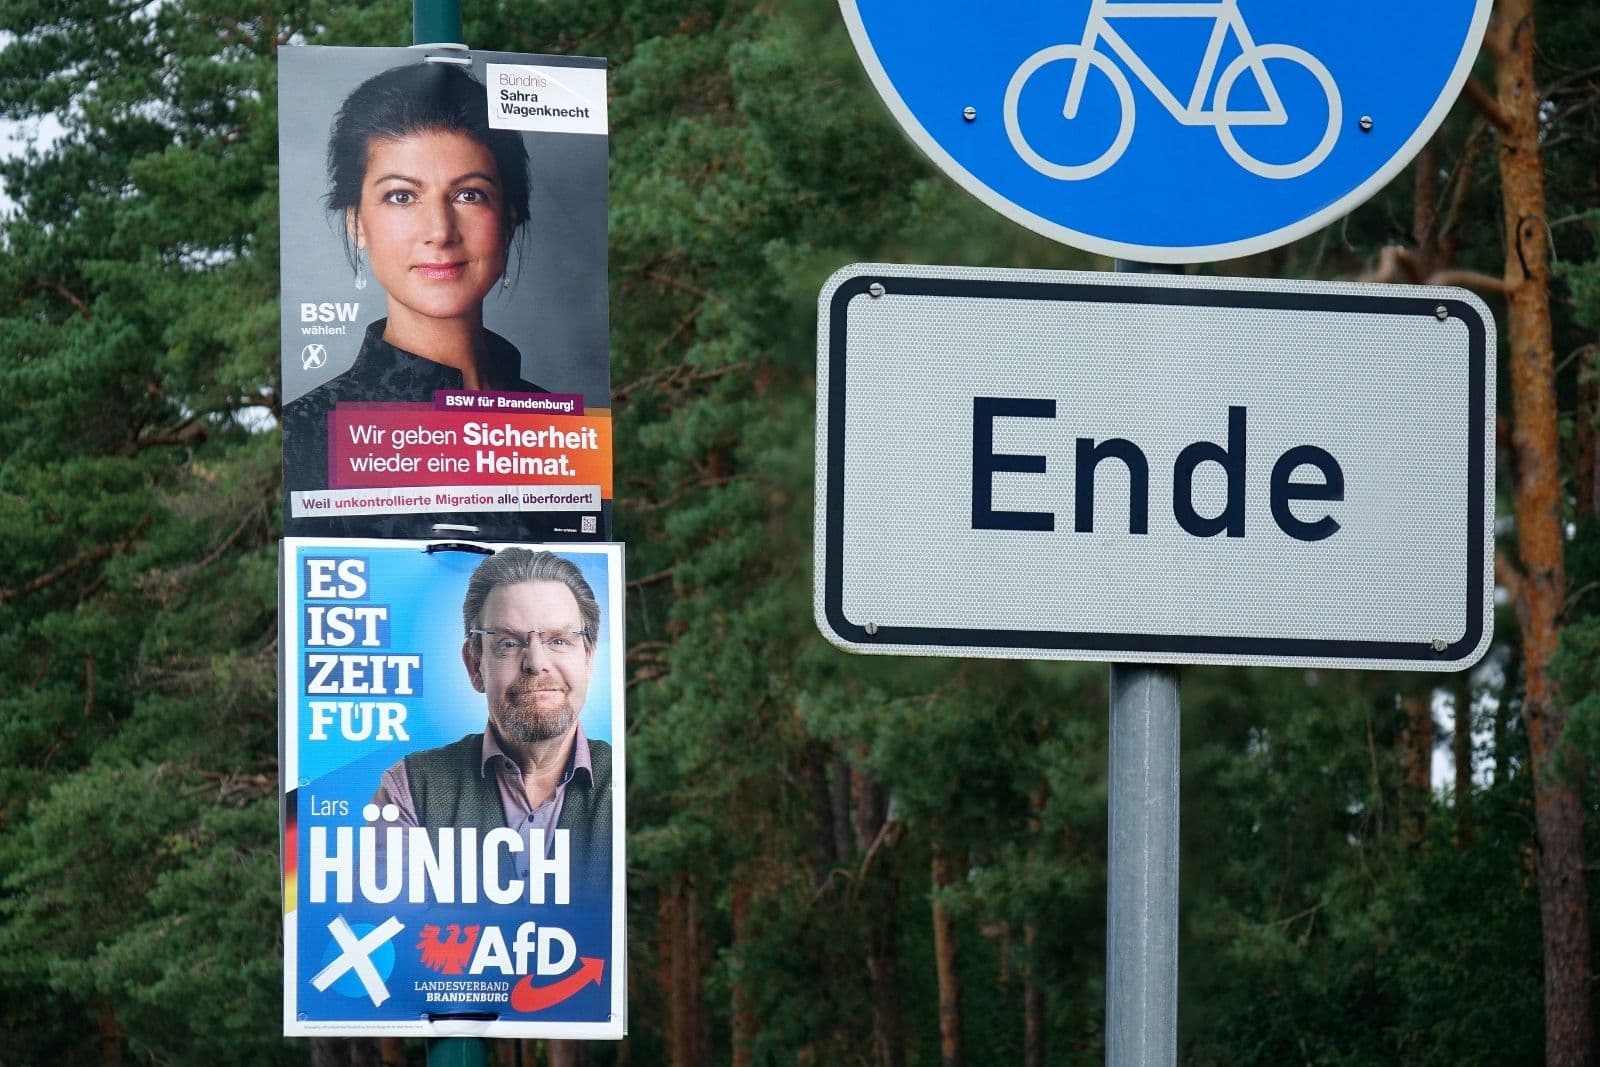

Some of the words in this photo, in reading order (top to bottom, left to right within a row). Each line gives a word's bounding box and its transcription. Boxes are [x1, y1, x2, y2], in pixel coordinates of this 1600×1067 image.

[499, 73, 547, 87] Bündnis
[500, 89, 538, 102] Sahra
[501, 103, 590, 118] Wagenknecht
[301, 302, 360, 322] BSW
[301, 325, 346, 335] wählen!
[445, 395, 474, 407] BSW
[477, 396, 494, 407] für
[497, 397, 575, 412] Brandenburg!
[349, 424, 385, 445] Wir
[391, 426, 457, 449] geben
[463, 422, 598, 450] Sicherheit
[349, 453, 422, 472] wieder
[427, 454, 470, 473] eine
[476, 450, 576, 477] Heimat.
[970, 396, 1345, 542] Ende
[302, 498, 331, 509] Weil
[335, 495, 432, 508] unkontrollierte
[435, 494, 494, 506] Migration
[497, 493, 519, 504] alle
[522, 493, 593, 504] überfordert!
[307, 559, 367, 599] ES
[307, 606, 387, 646] IST
[307, 654, 420, 695] ZEIT
[311, 794, 349, 817] Lars
[309, 803, 570, 905] HÜNICH
[468, 921, 577, 976] AfD
[414, 981, 509, 991] LANDESVERBAND
[426, 992, 509, 1002] BRANDENBURG
